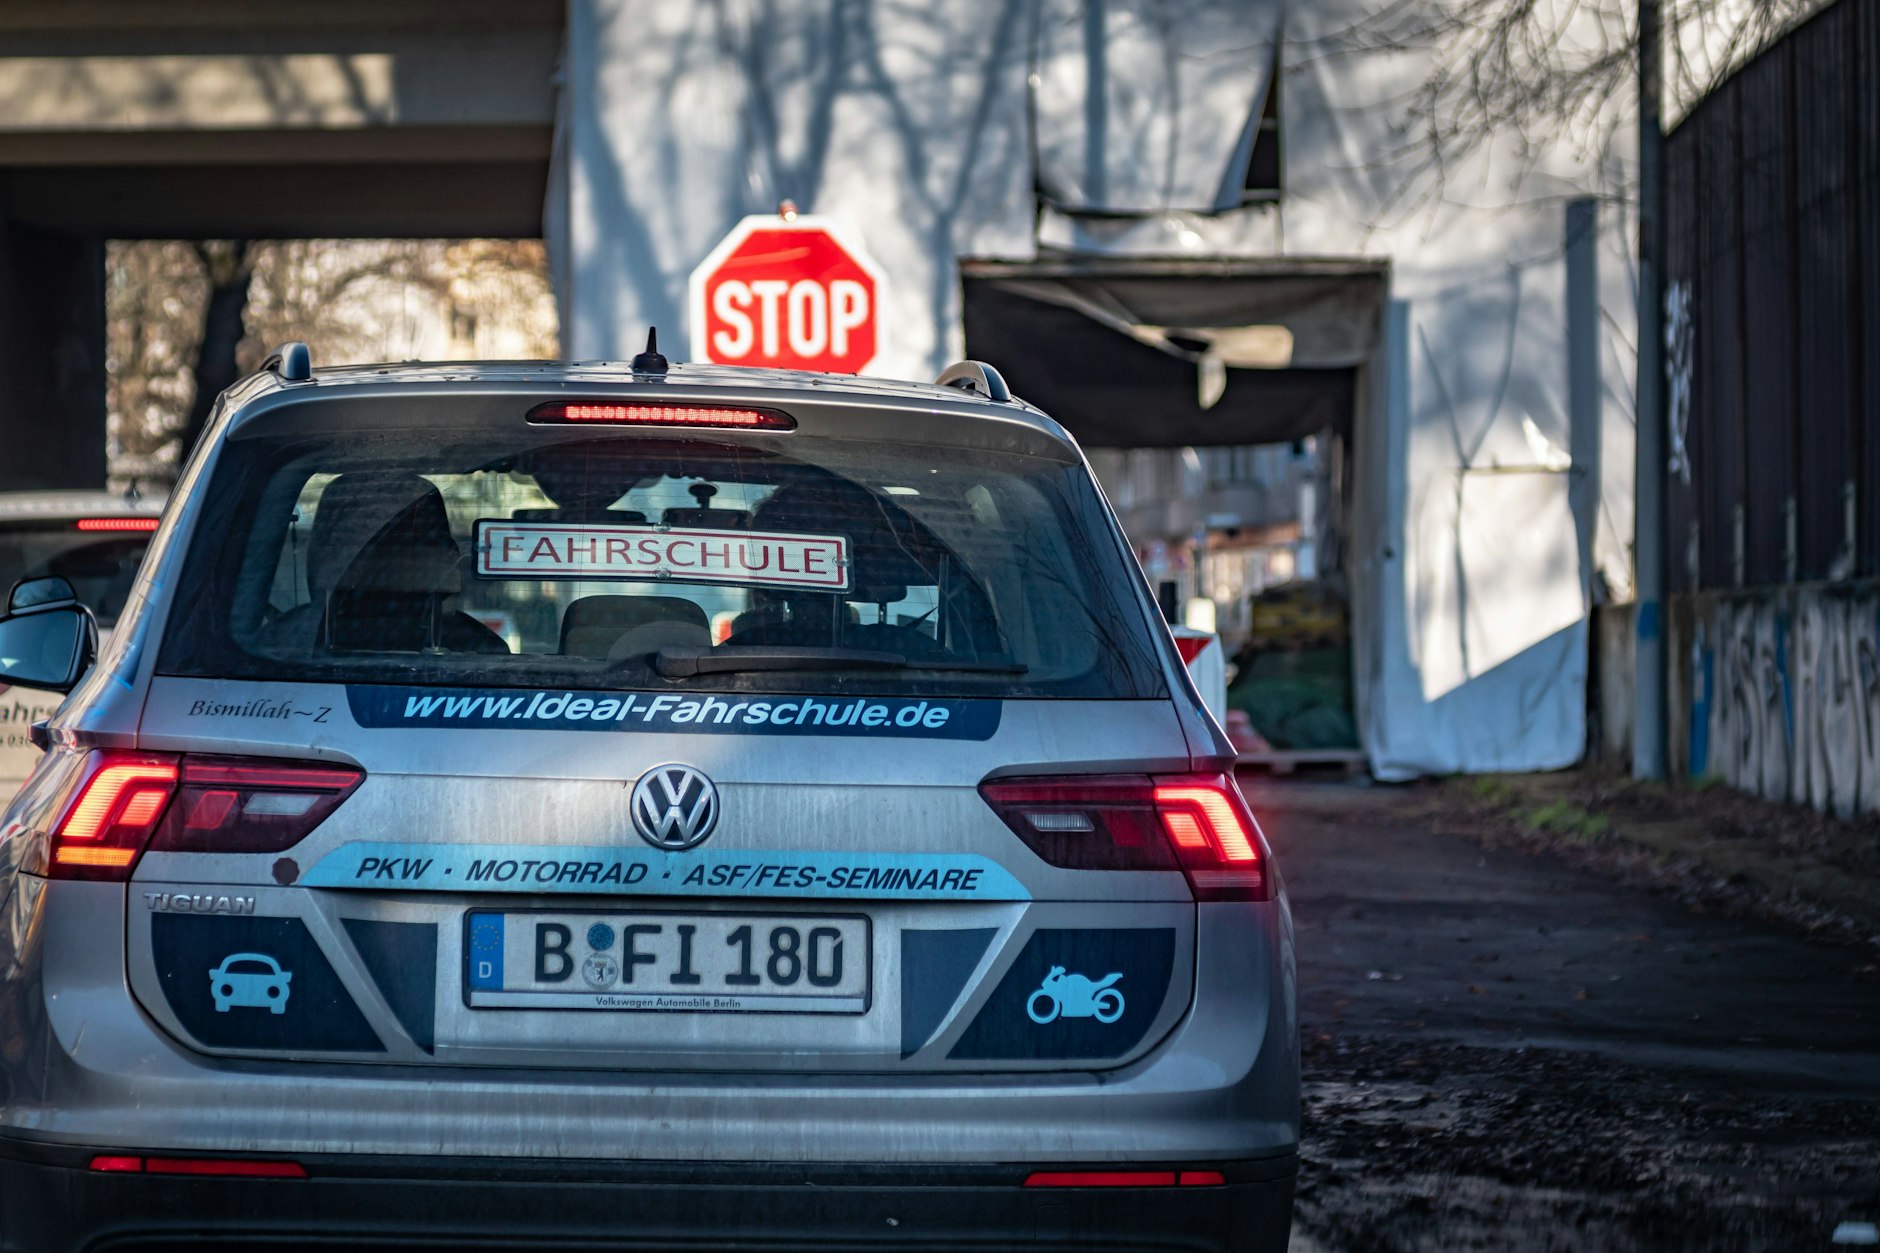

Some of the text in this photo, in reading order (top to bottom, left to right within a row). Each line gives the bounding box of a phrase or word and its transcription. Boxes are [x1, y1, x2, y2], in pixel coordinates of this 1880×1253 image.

[712, 279, 869, 359] STOP
[502, 536, 827, 575] FAHRSCHULE
[403, 692, 950, 729] www.Ideal-Fahrschule.de
[635, 766, 715, 846] VW
[355, 857, 984, 891] PKW MOTORRAD ASF/FES-SEMINARE
[143, 892, 255, 915] TIGUAN
[478, 961, 492, 979] D
[534, 922, 844, 987] B FI 180
[596, 997, 741, 1009] Volkswagen Automobile Berlin
